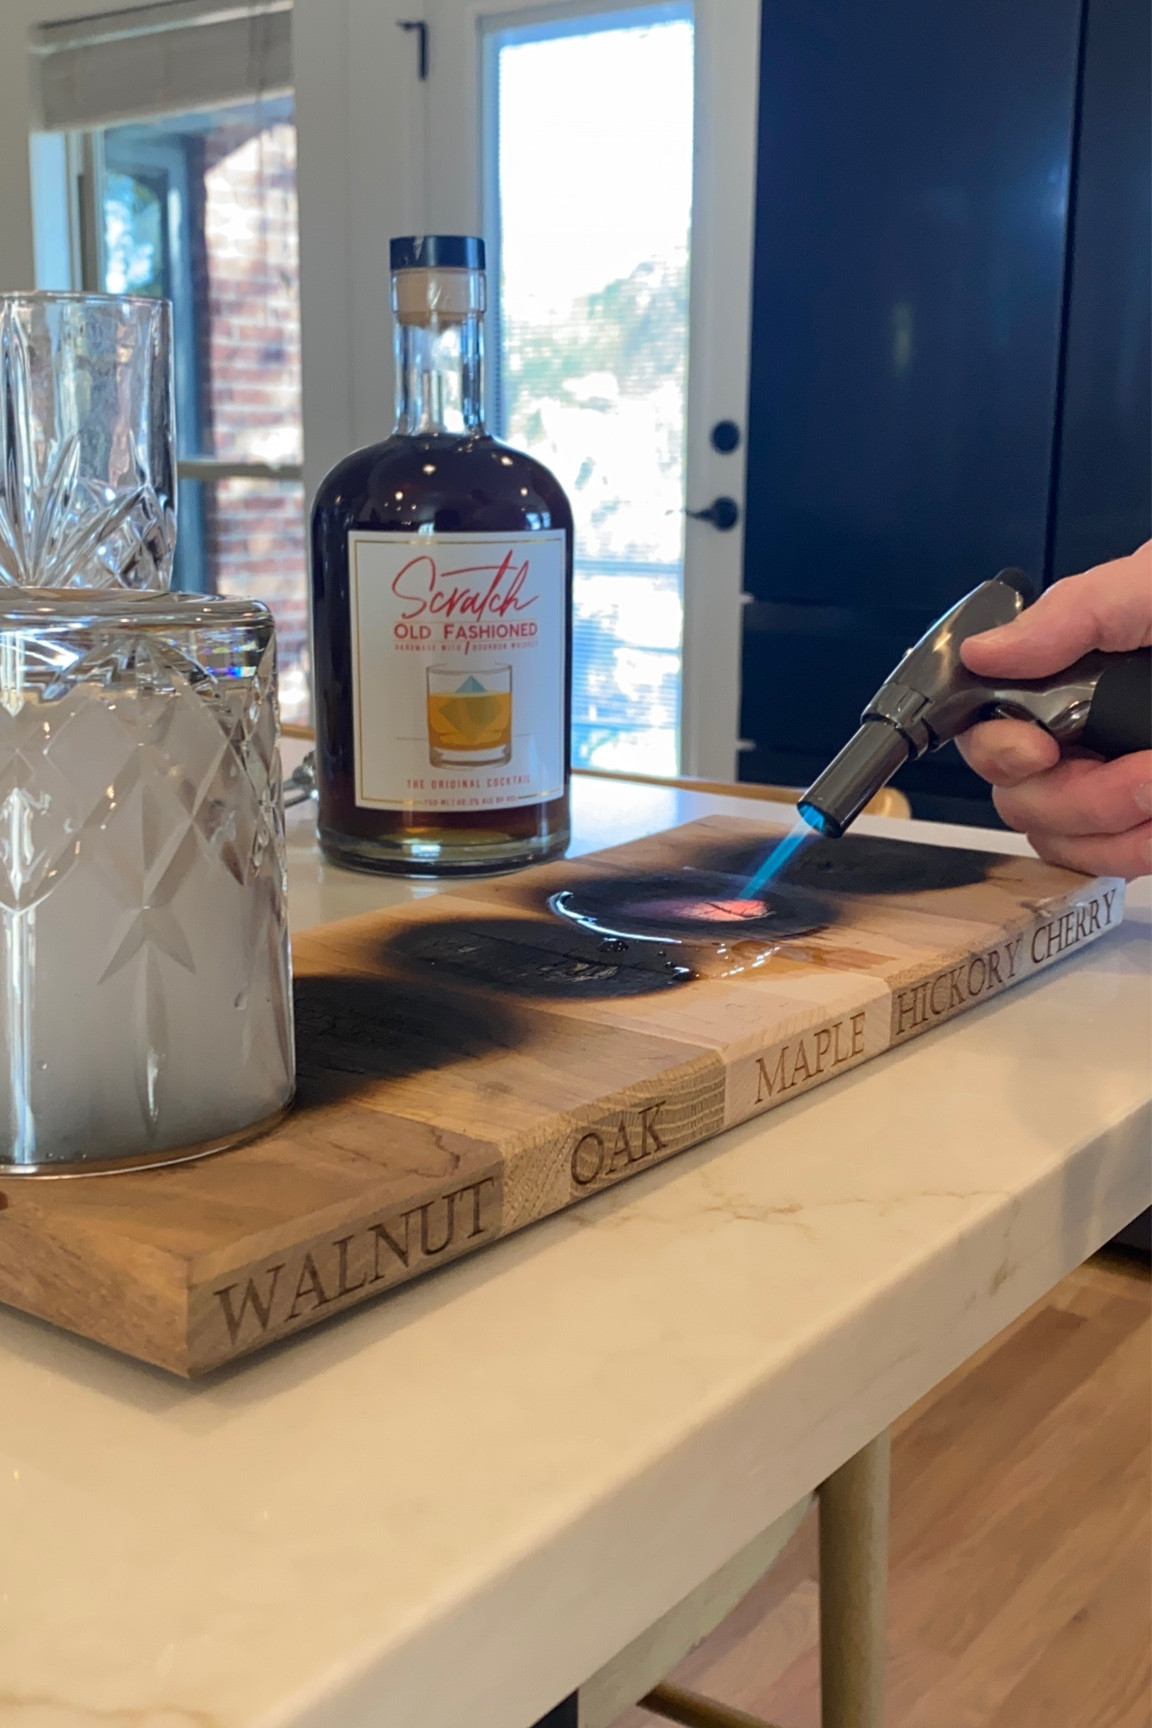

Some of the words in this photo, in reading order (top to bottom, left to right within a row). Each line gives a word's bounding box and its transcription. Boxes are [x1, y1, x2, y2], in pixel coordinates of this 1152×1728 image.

[391, 549, 539, 622] Scratch
[394, 623, 431, 640] OLD
[444, 622, 539, 640] FASHIONED
[406, 778, 425, 790] THE
[431, 778, 481, 790] ORIGINAL
[487, 774, 531, 788] COCKTAIL
[213, 1177, 496, 1346] WALNUT
[571, 1100, 667, 1185] OAK
[755, 1013, 866, 1105] MAPLE
[895, 938, 1024, 1036] HICKORY
[1031, 889, 1118, 964] CHERRY
